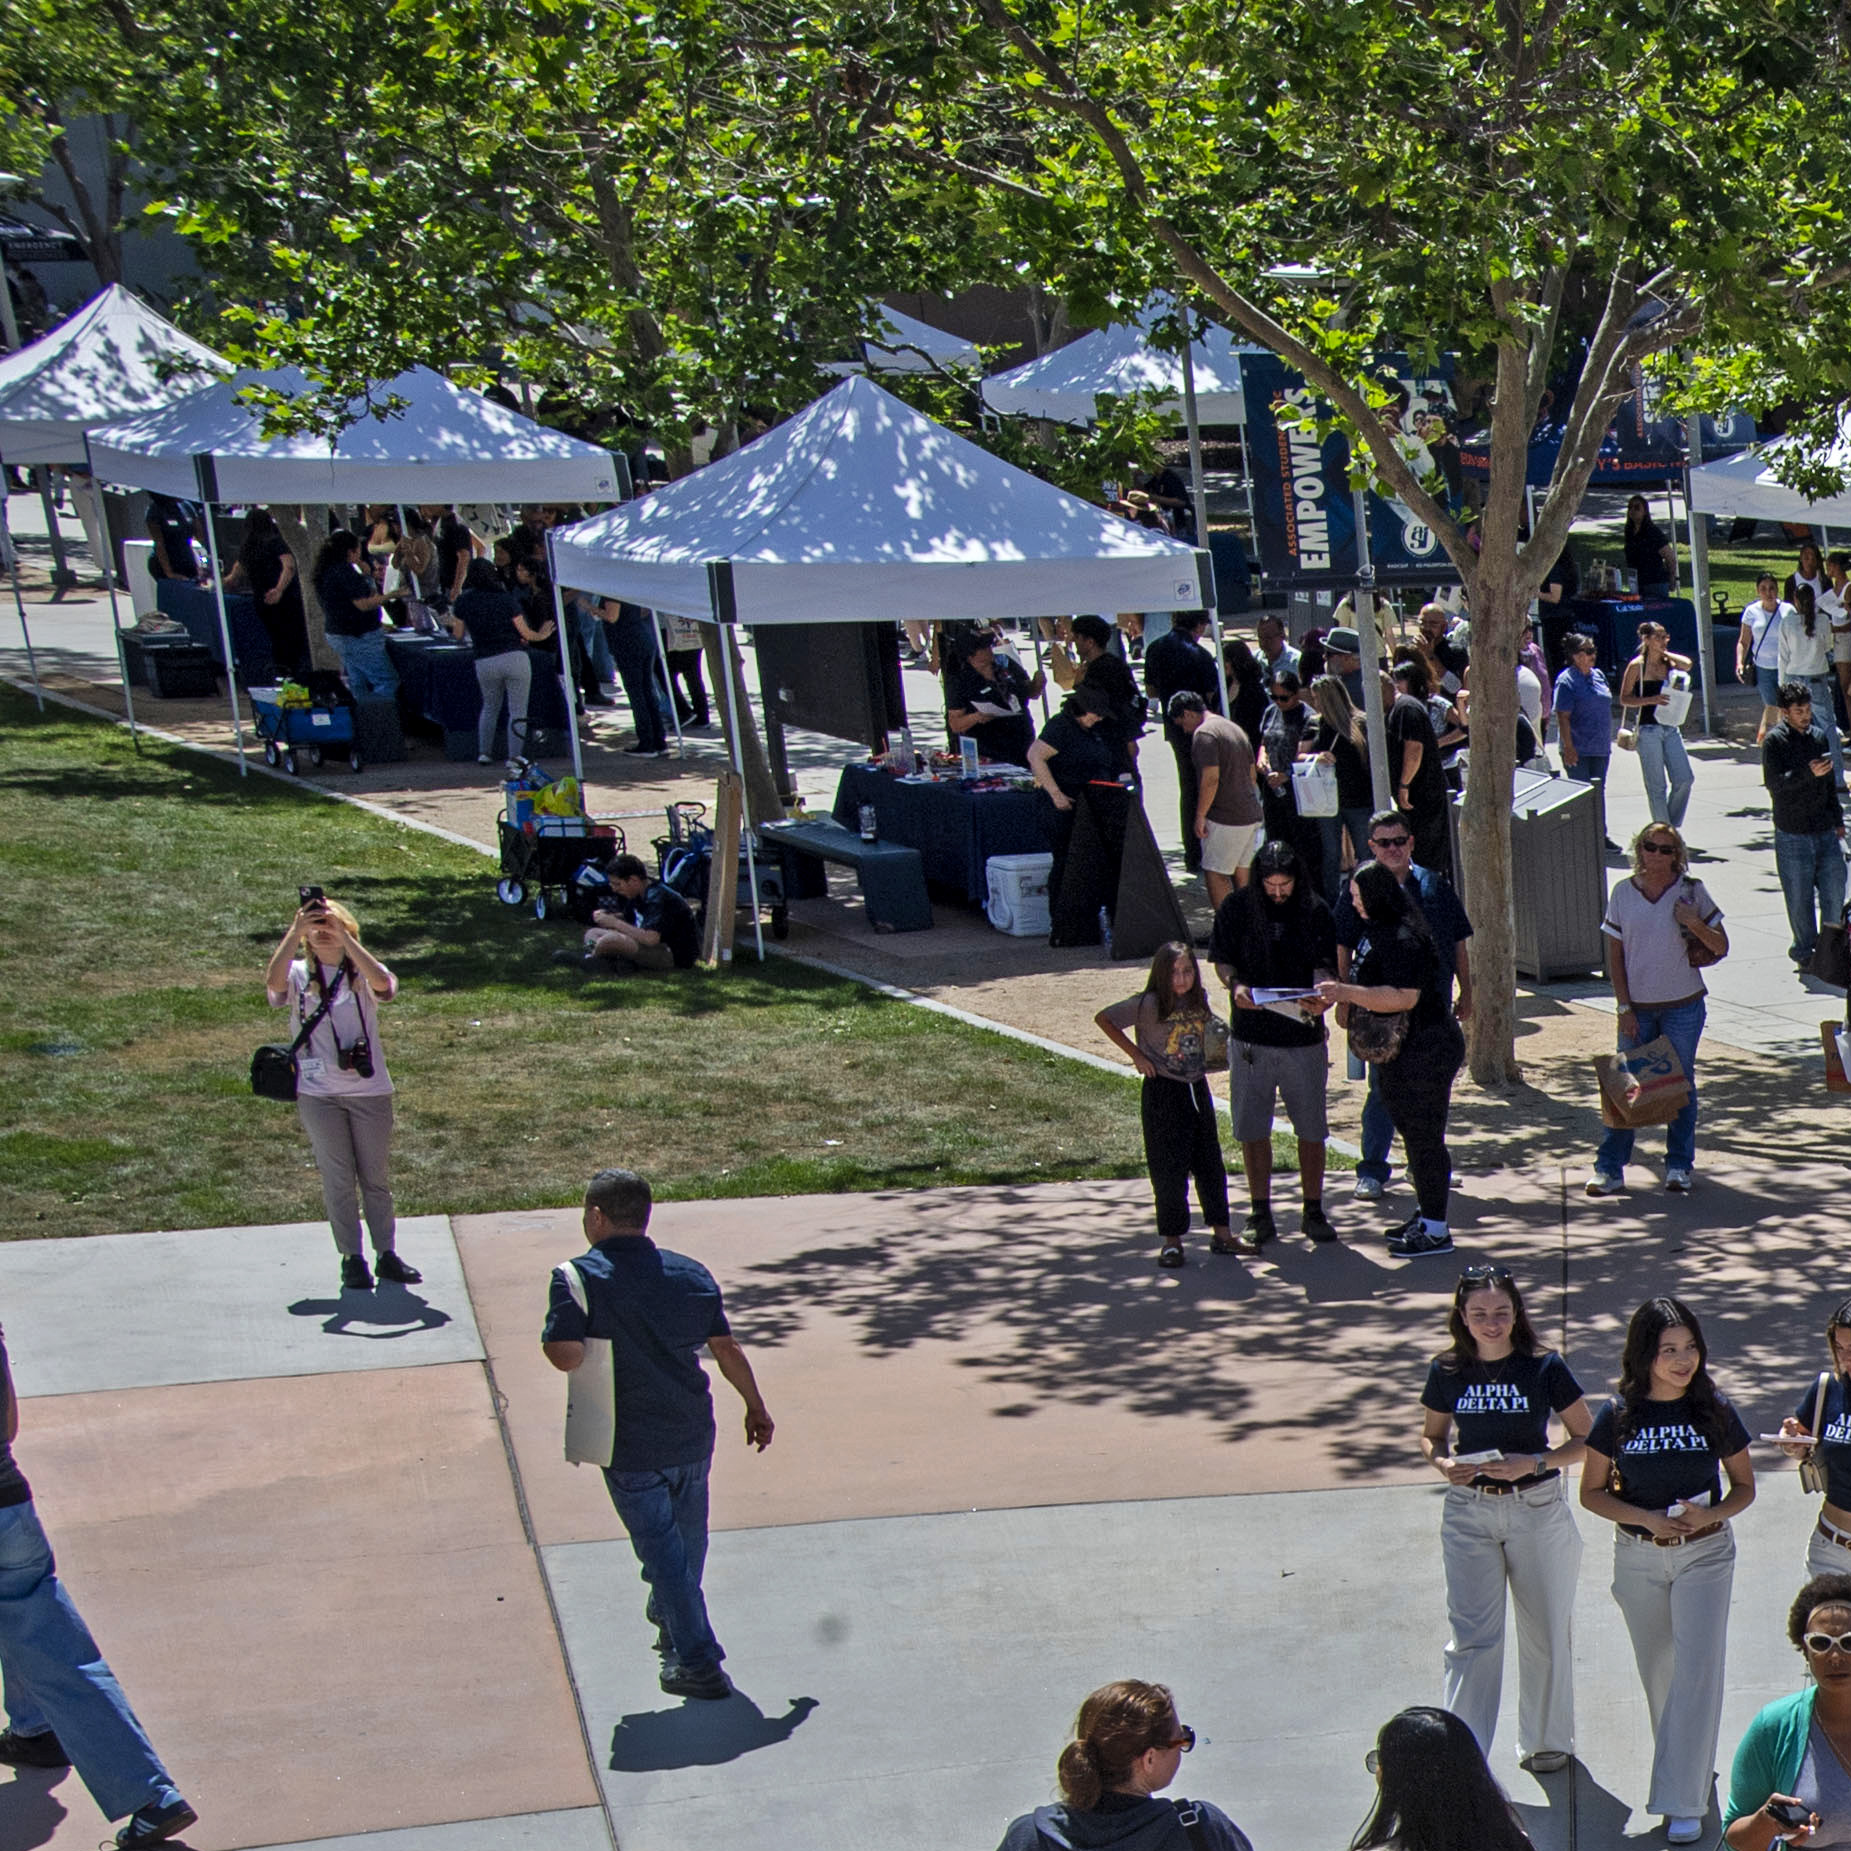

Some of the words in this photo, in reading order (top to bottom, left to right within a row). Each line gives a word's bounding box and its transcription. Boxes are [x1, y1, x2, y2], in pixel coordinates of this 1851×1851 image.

[1282, 480, 1298, 556] ASSOCIATED
[1464, 1384, 1520, 1397] ALPHA
[1456, 1397, 1508, 1410] DELTA
[1512, 1396, 1528, 1409] PI
[1636, 1424, 1697, 1439] ALPHA
[1625, 1438, 1686, 1450] DELTA
[1690, 1436, 1708, 1447] PI
